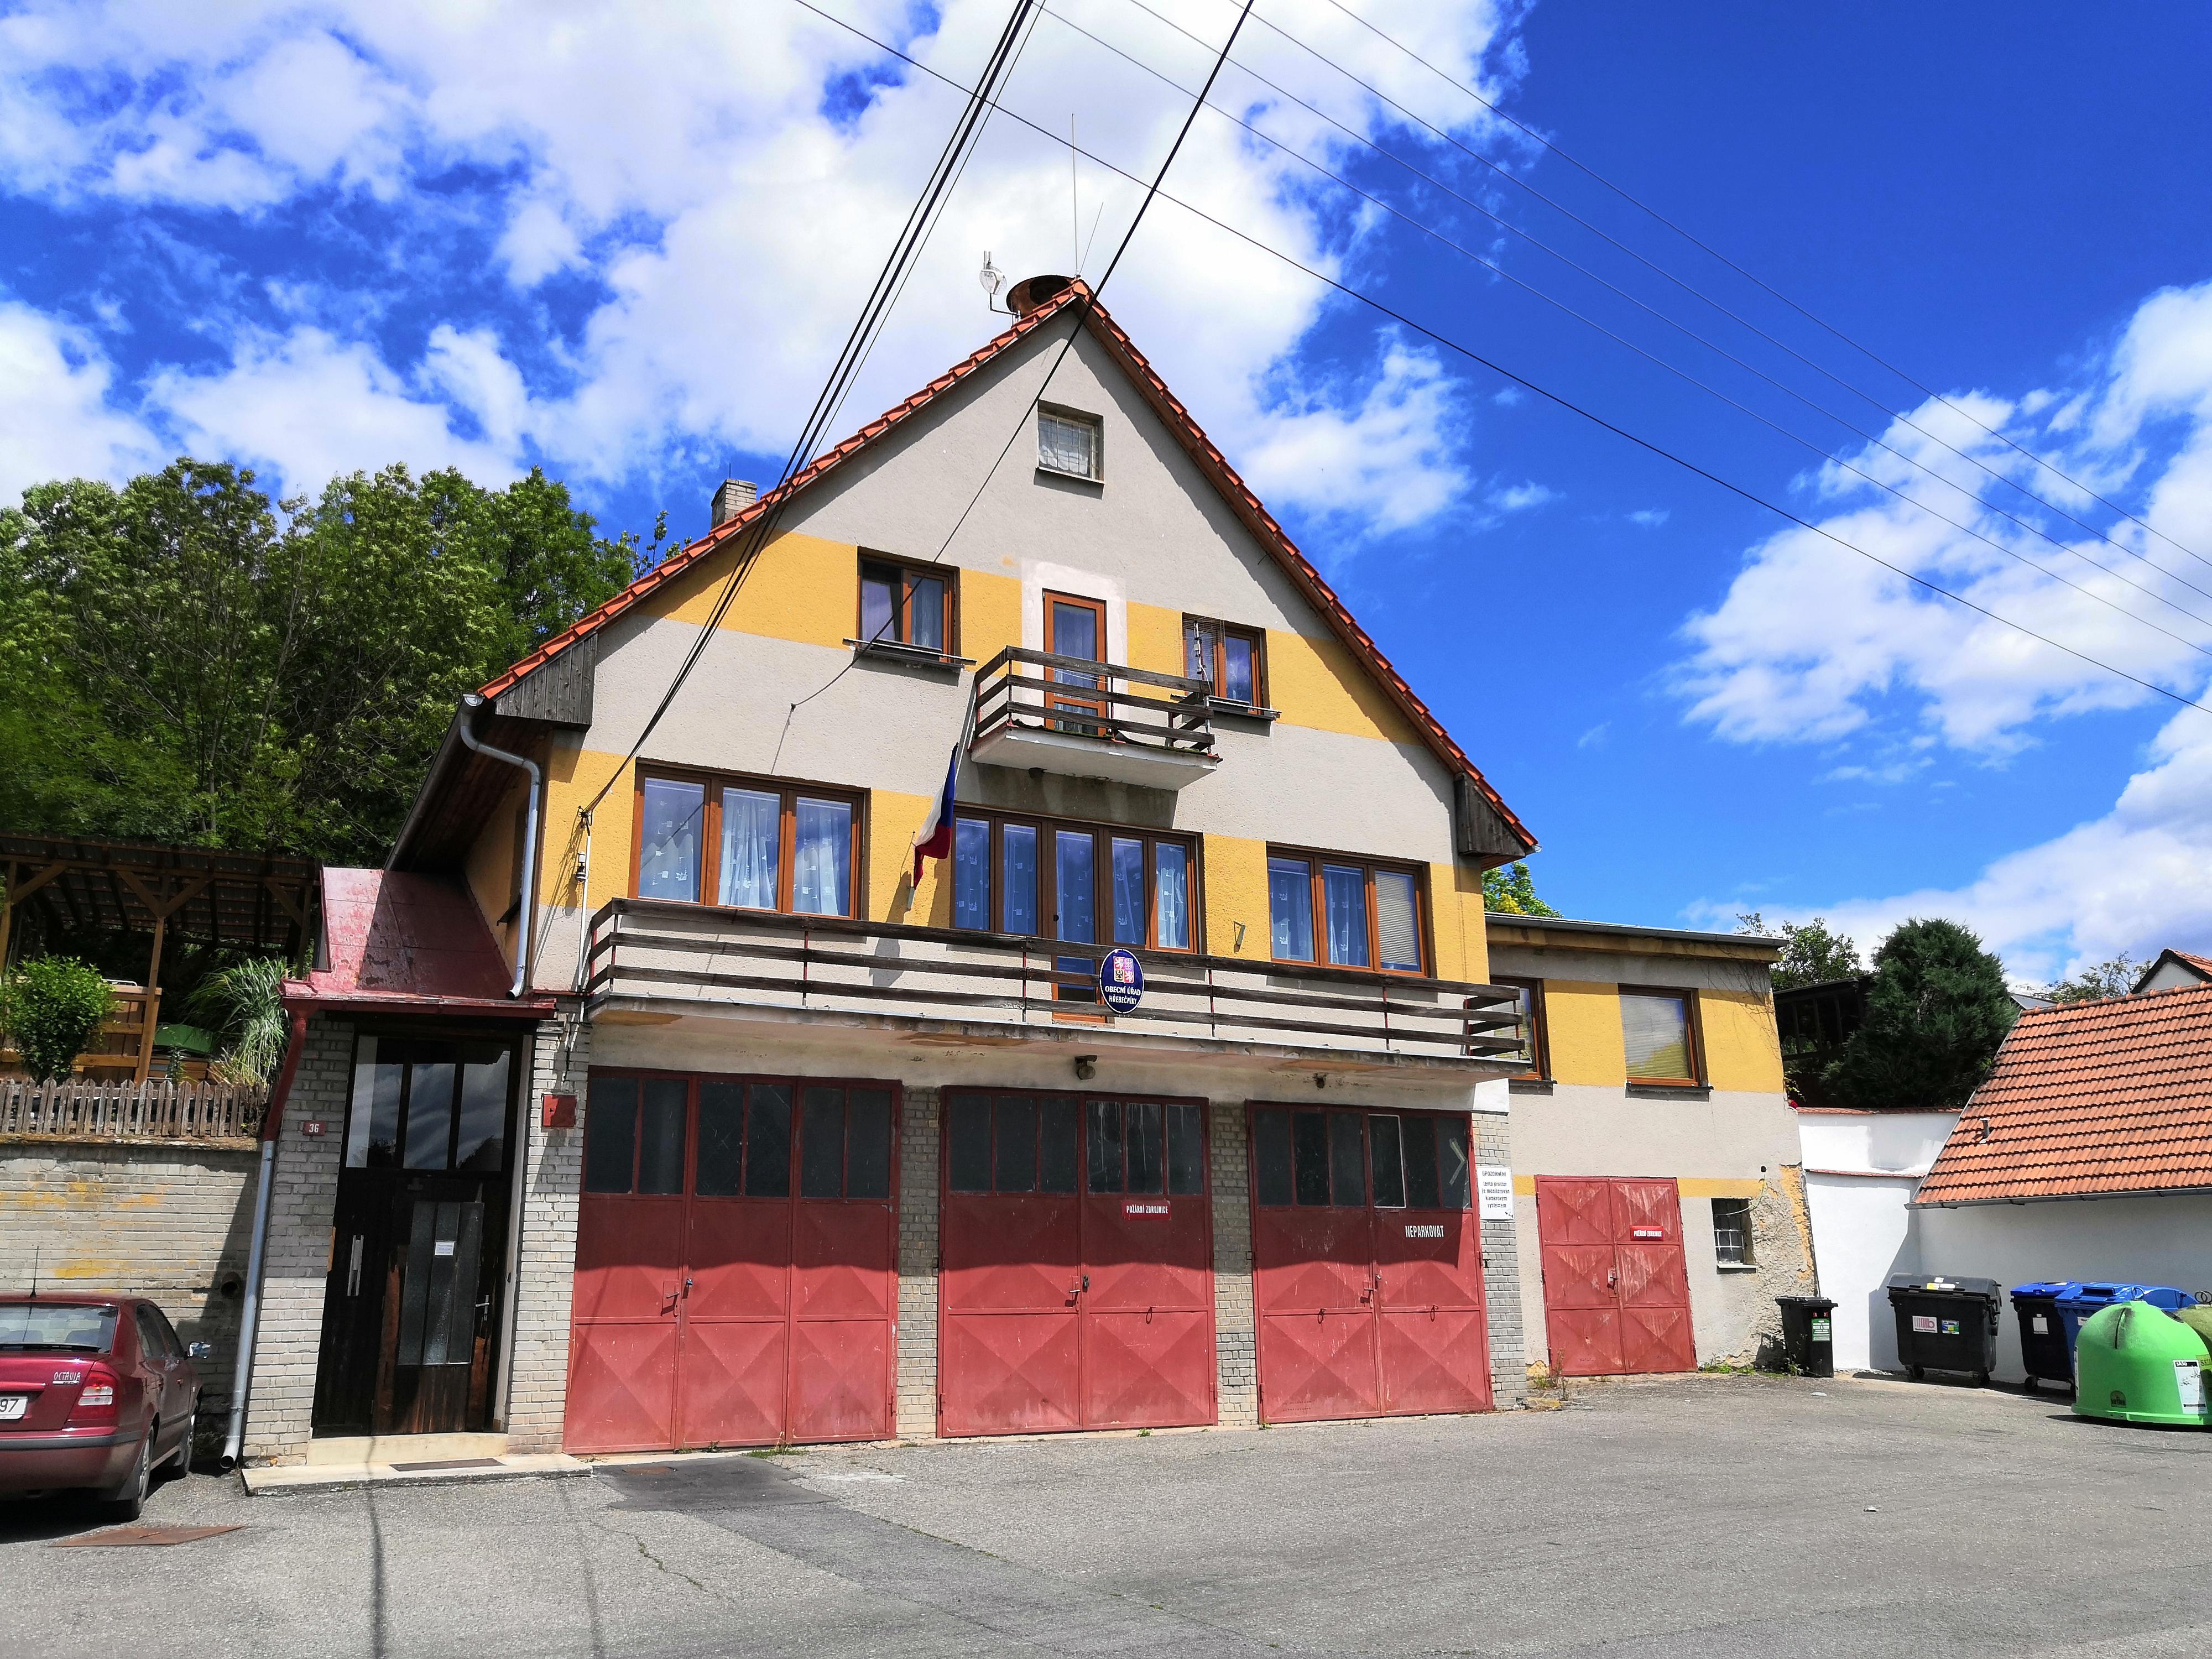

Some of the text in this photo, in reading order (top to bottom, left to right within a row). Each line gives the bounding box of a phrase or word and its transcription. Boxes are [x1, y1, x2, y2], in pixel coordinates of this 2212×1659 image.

[1105, 985, 1141, 995] OBECNÍ ÚŘAD
[1109, 994, 1137, 1005] HŘEBEČNÍKY
[309, 1123, 320, 1133] 36
[1126, 1204, 1168, 1214] POŽÁRNÍ ZBROJNICE
[1405, 1225, 1444, 1238] NEPARKOVAT
[54, 1371, 81, 1381] OCTAVIA
